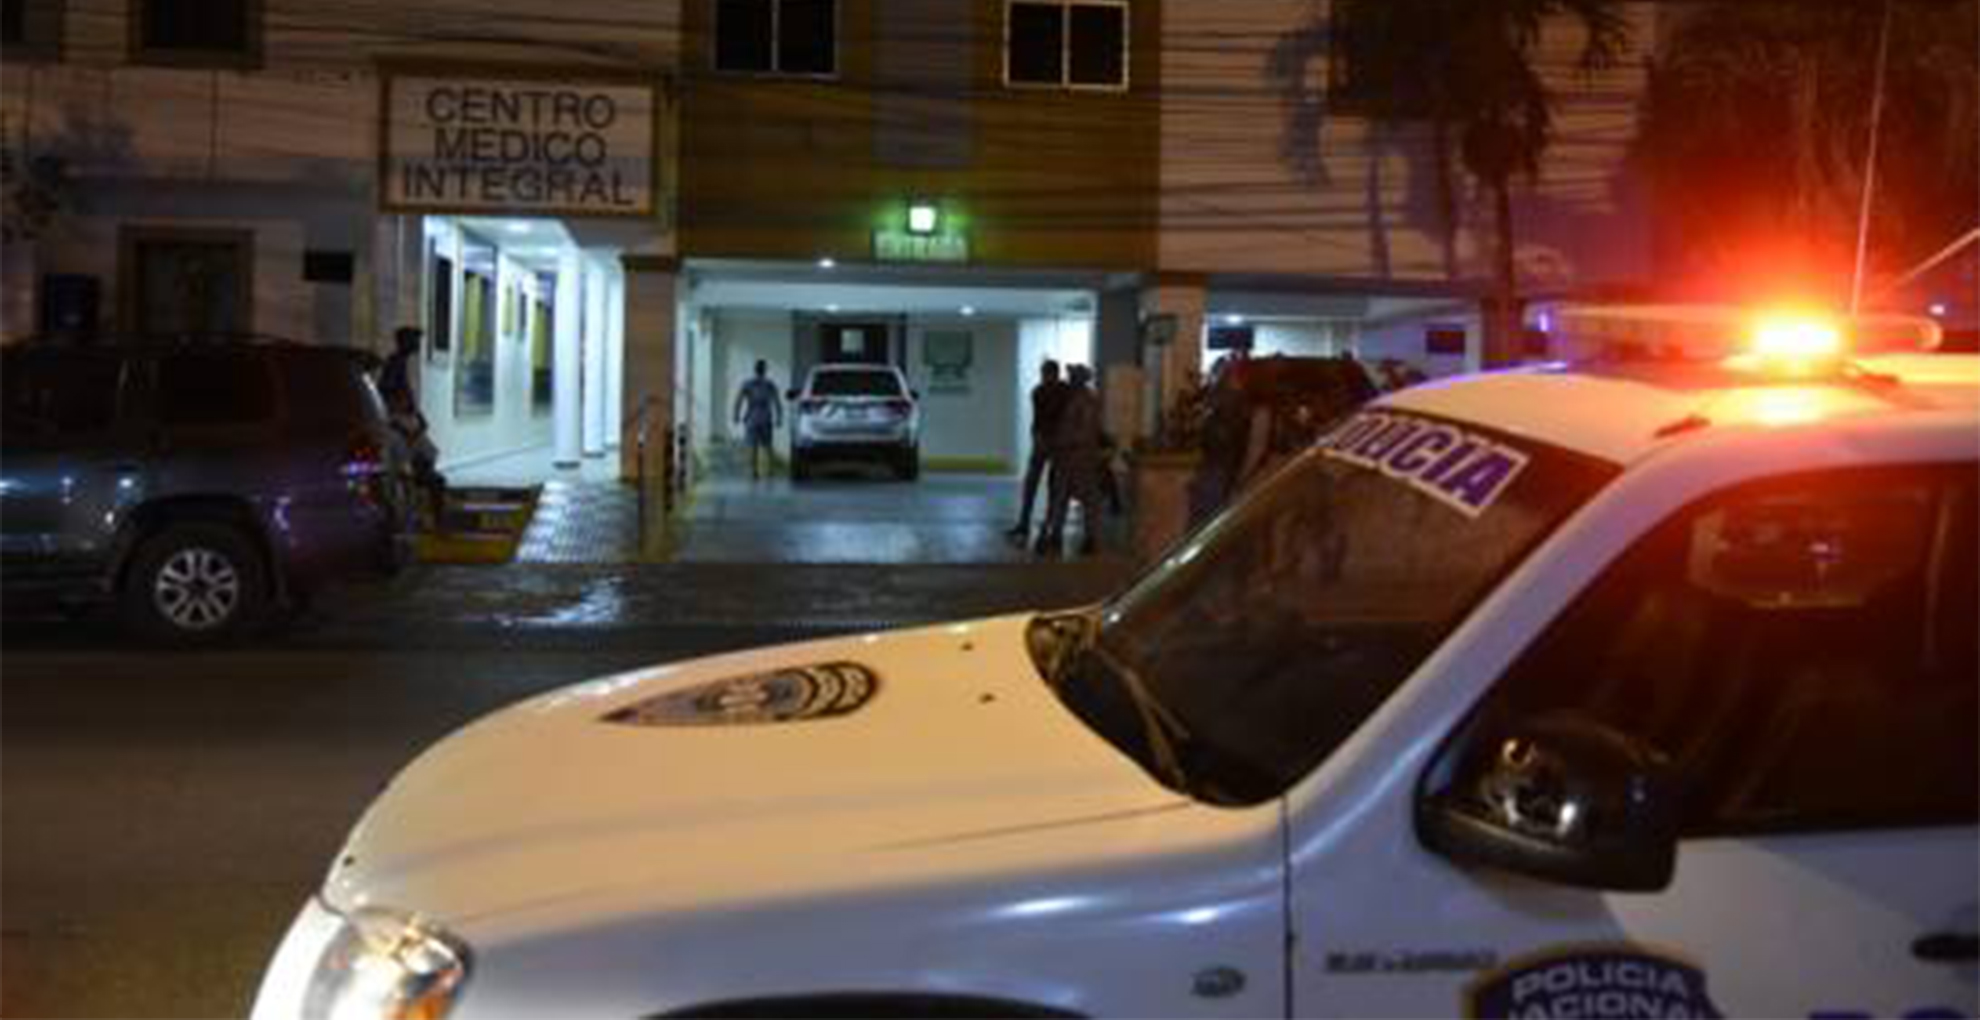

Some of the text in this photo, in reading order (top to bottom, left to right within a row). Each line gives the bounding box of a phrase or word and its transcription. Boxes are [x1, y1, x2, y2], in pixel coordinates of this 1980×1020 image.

[426, 86, 616, 129] CENTRO
[434, 126, 607, 168] MEDICO
[404, 162, 636, 206] INTEGRAL
[1328, 413, 1528, 514] OLICIA
[1511, 959, 1690, 1003] POLICIA
